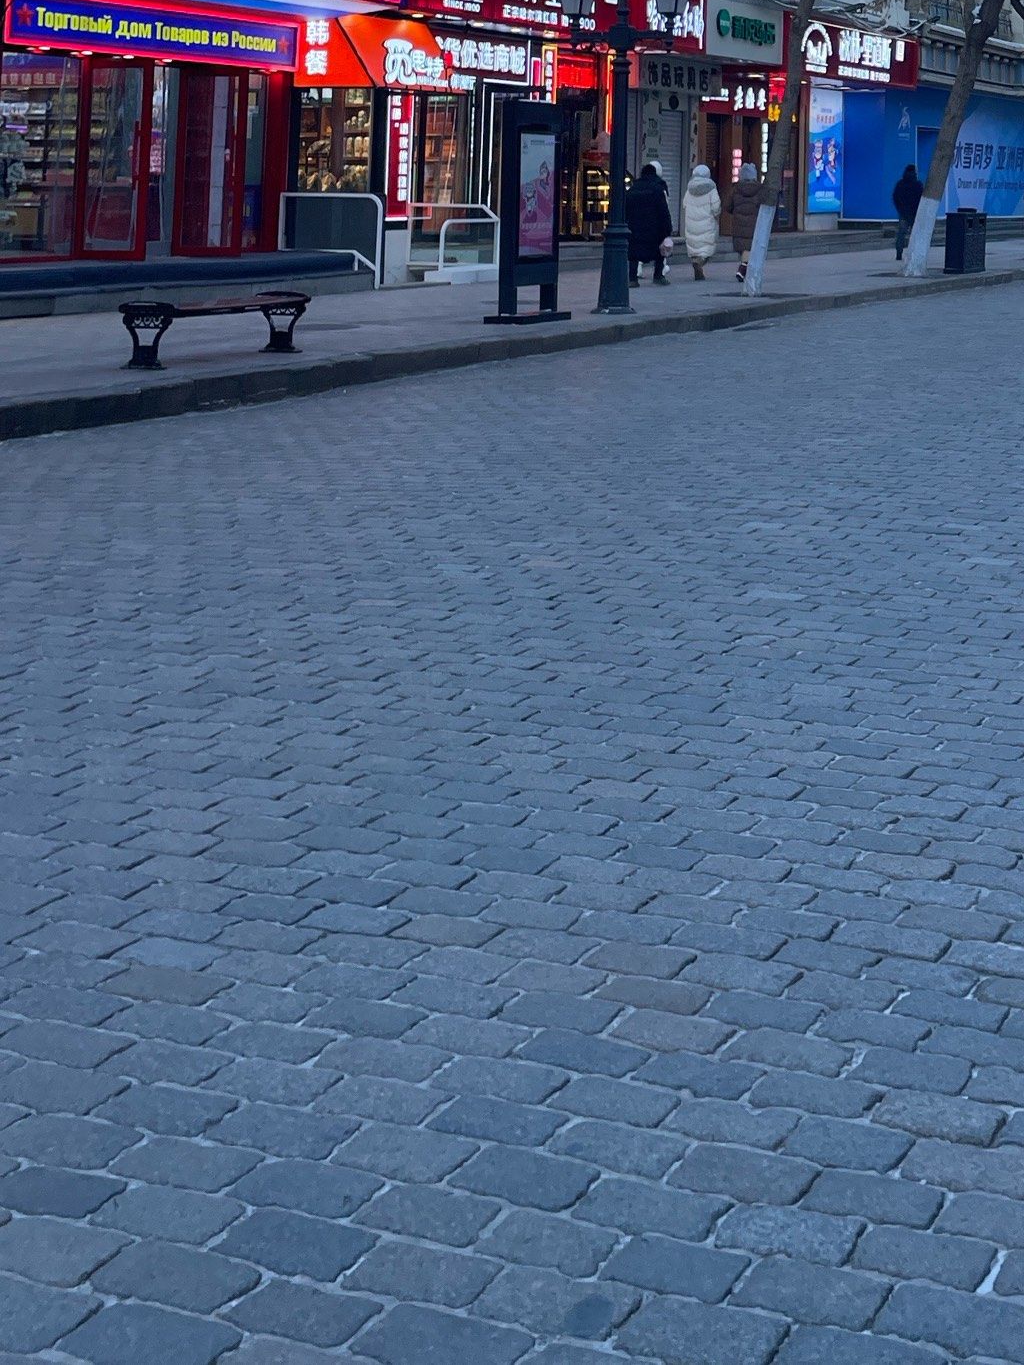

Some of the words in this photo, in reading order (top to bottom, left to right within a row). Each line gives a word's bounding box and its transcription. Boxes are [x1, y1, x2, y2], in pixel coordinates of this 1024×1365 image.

[36, 6, 112, 34] Торговый
[155, 22, 210, 46] Товаров
[212, 31, 229, 48] из
[231, 31, 277, 53] России
